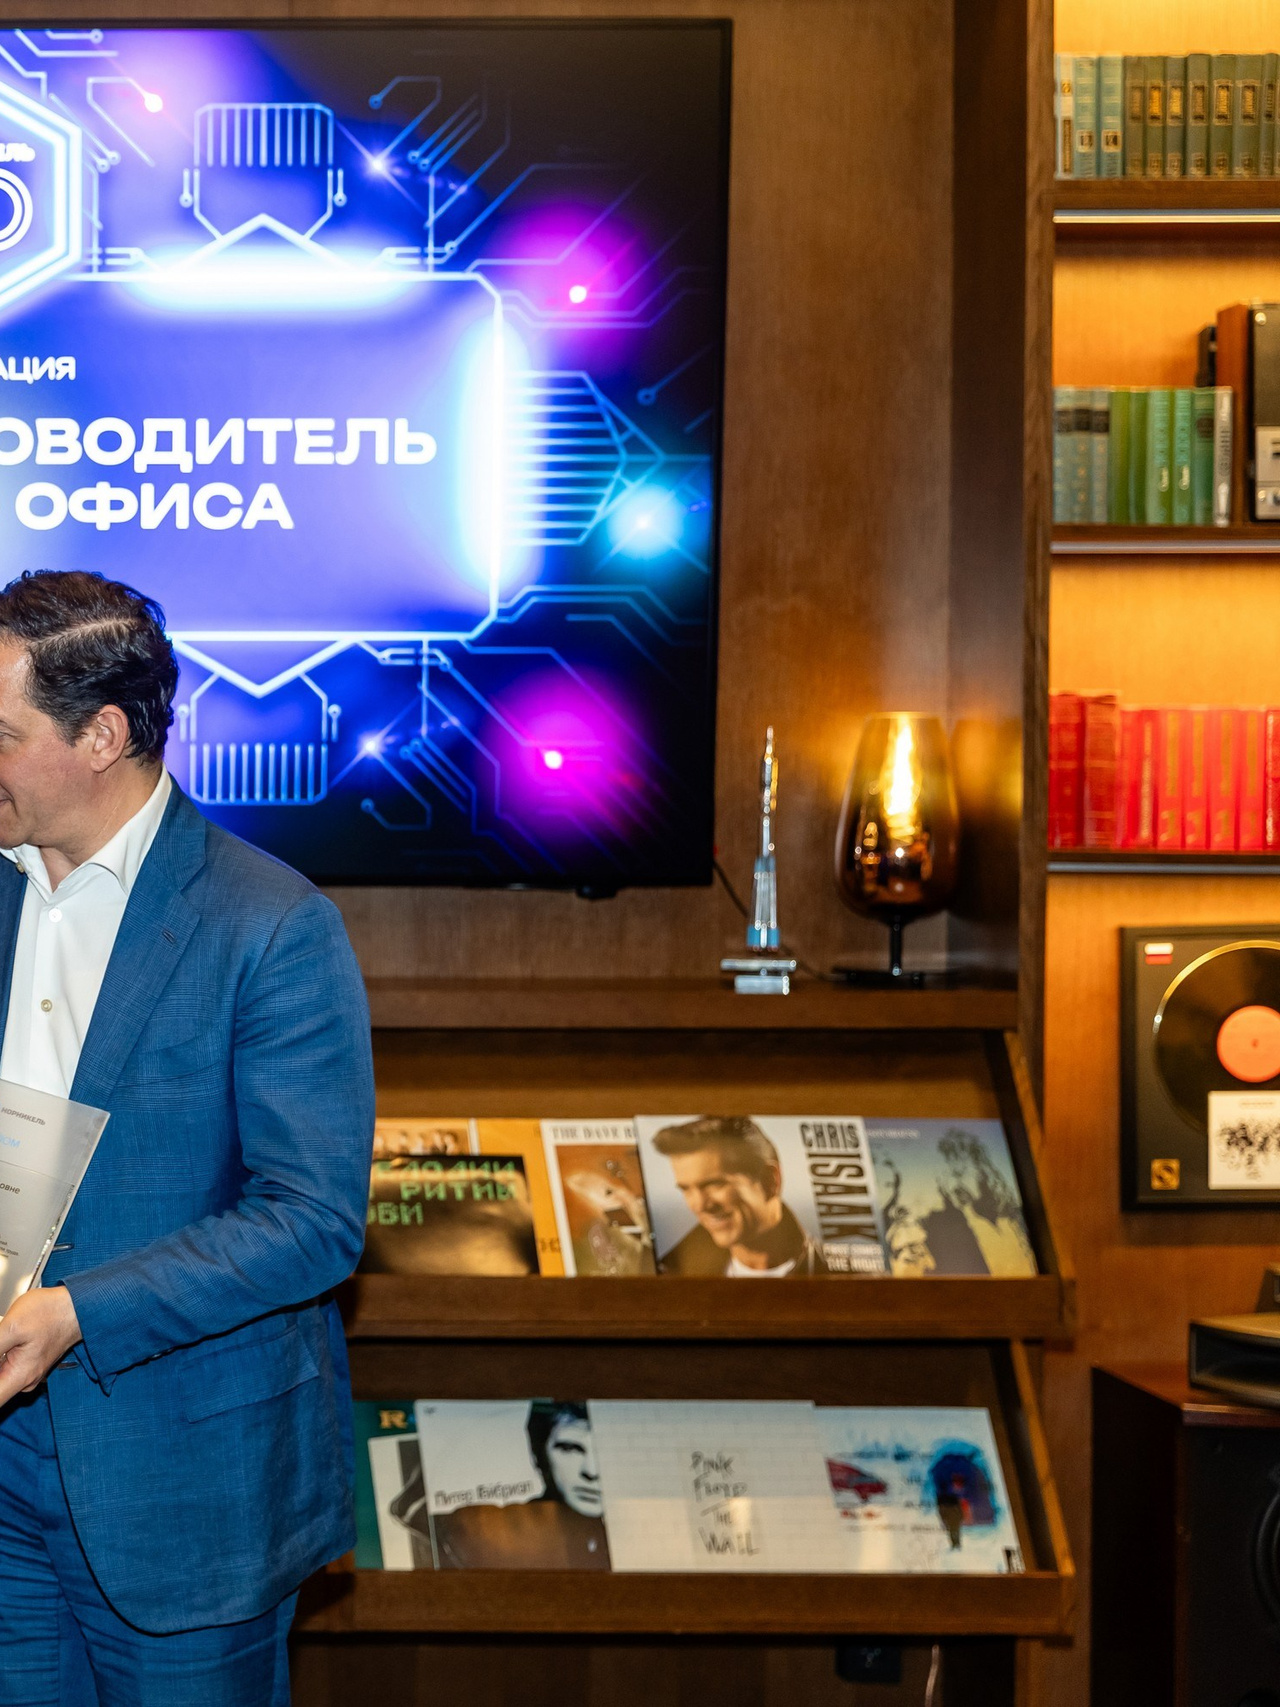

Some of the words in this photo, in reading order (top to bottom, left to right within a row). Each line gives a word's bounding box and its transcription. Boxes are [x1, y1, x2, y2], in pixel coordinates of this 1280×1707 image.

[15, 484, 293, 531] ОФИСА
[1, 1106, 46, 1126] НОРНИКЕЛЬ
[800, 1122, 860, 1149] CHRIS
[806, 1152, 879, 1241] ISAAK
